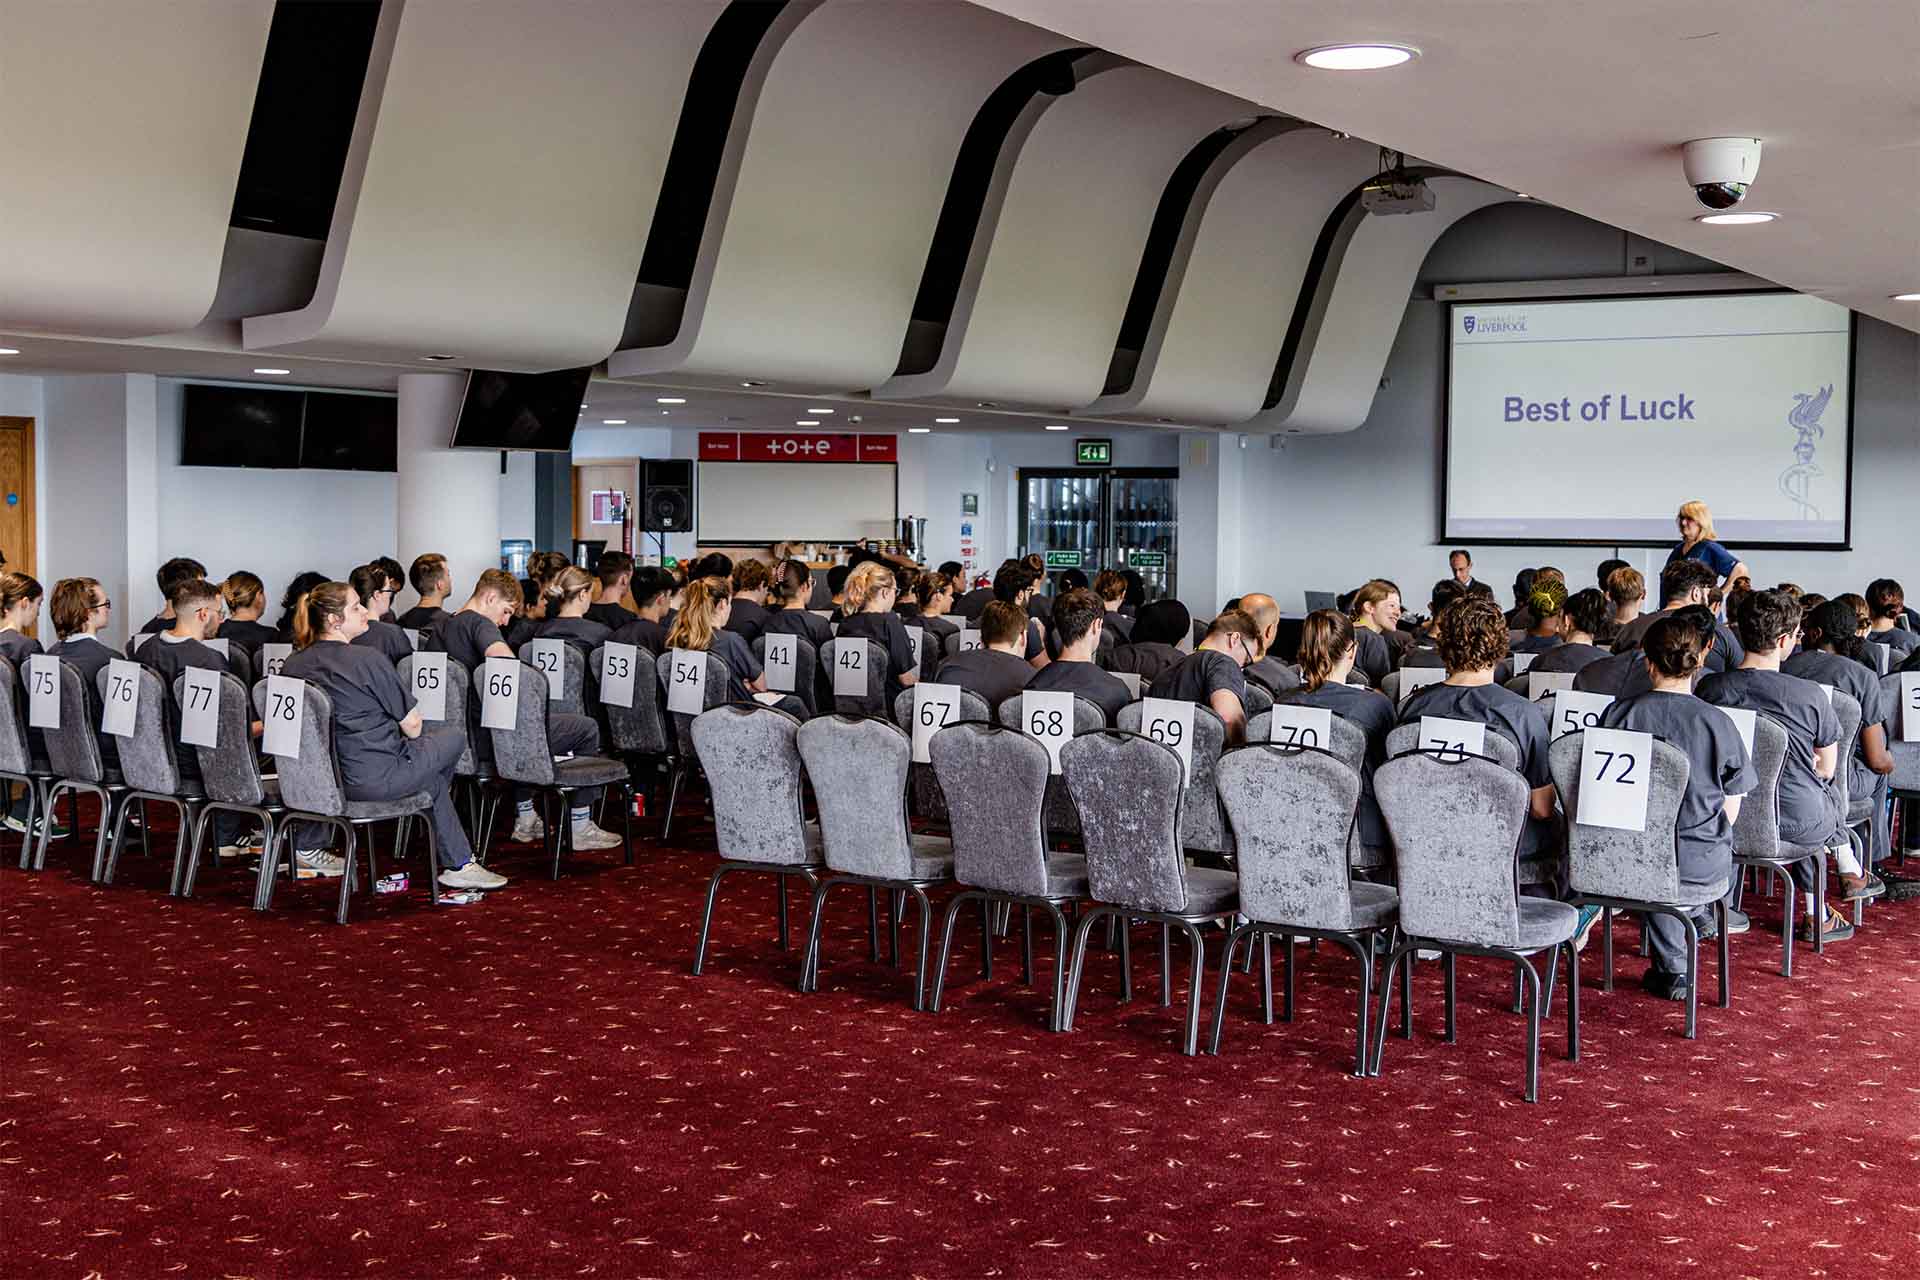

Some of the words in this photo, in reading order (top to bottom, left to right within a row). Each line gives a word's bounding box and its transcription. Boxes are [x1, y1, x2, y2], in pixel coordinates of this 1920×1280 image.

[1504, 396, 1570, 422] Best
[1580, 394, 1611, 421] of
[1620, 393, 1695, 420] Luck
[537, 652, 558, 673] 52
[608, 656, 629, 678] 53
[770, 646, 790, 666] 41
[840, 651, 861, 670] 42
[34, 672, 54, 695] 75
[417, 667, 439, 689] 65
[489, 674, 512, 697] 66
[675, 663, 699, 686] 54
[112, 676, 132, 702] 76
[189, 684, 213, 712] 77
[272, 693, 295, 720] 78
[920, 701, 951, 728] 67
[1031, 710, 1063, 737] 68
[1150, 718, 1183, 747] 69
[1594, 750, 1636, 785] 72
